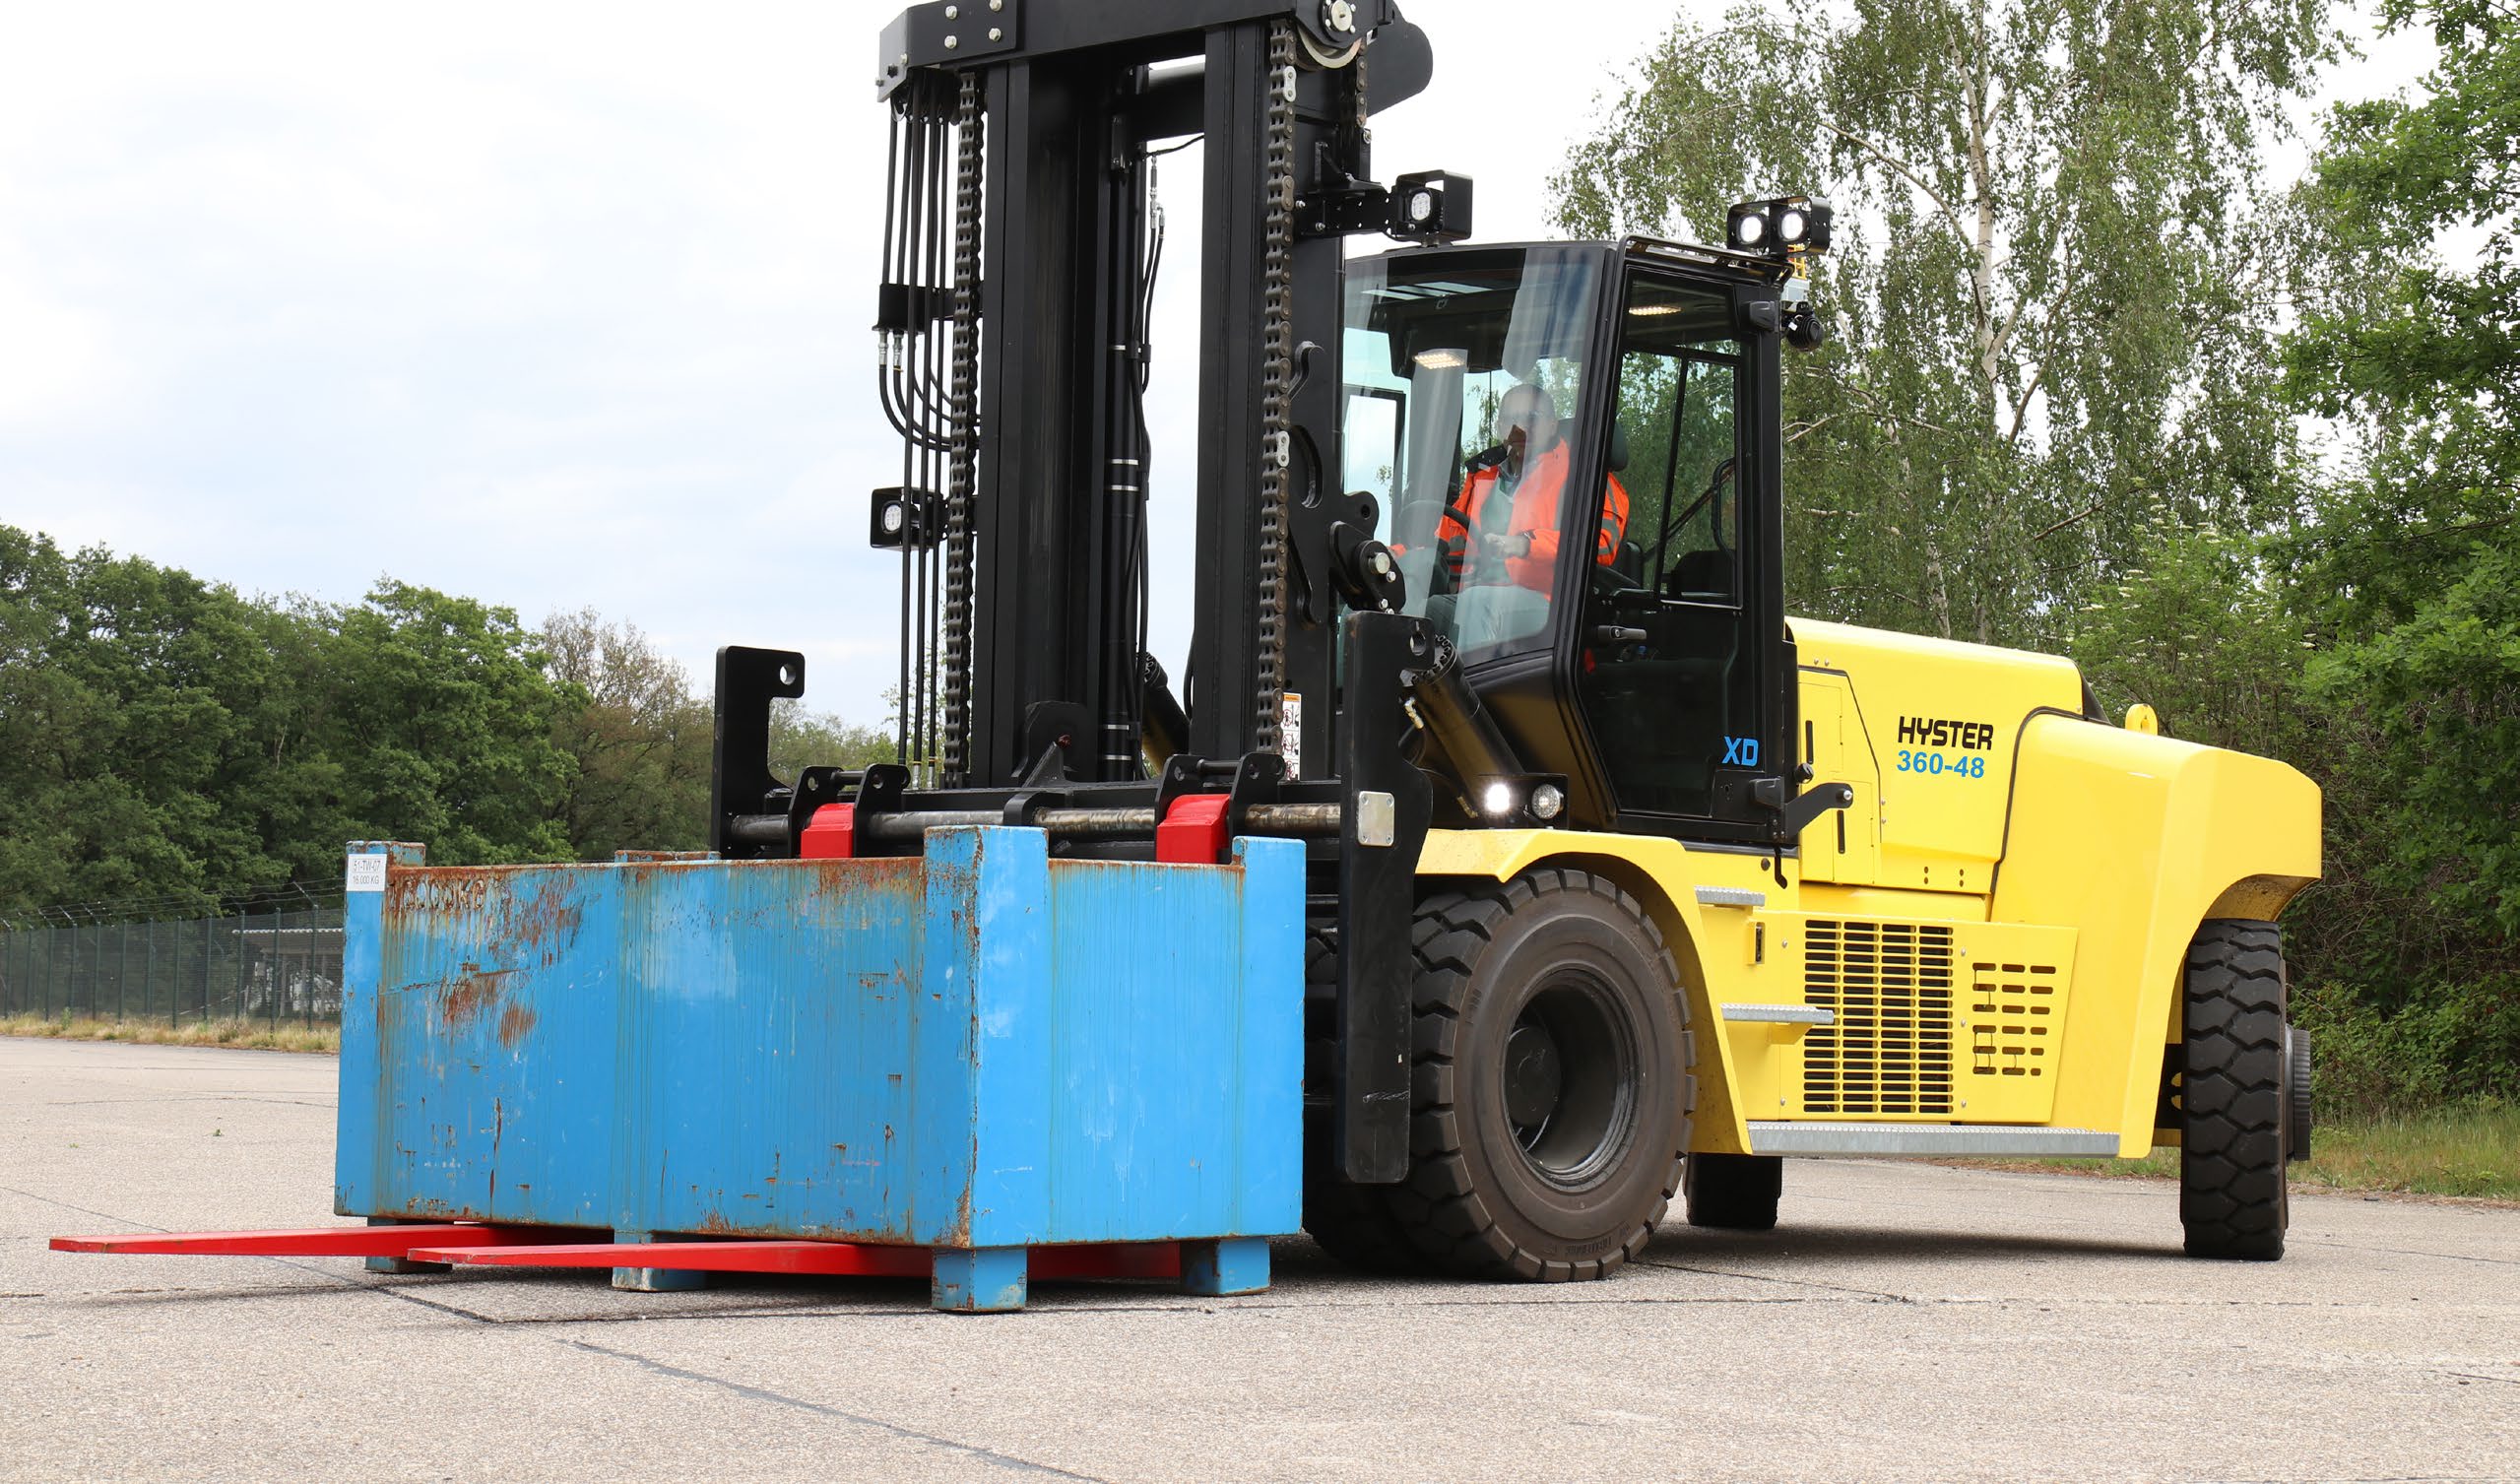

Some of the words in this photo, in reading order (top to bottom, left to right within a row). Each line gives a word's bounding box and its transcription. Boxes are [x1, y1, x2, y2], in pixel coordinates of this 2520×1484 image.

[1898, 716, 1994, 750] HYSTER
[1721, 736, 1759, 767] XD
[1897, 750, 1985, 779] 360-48
[370, 874, 380, 884] KG
